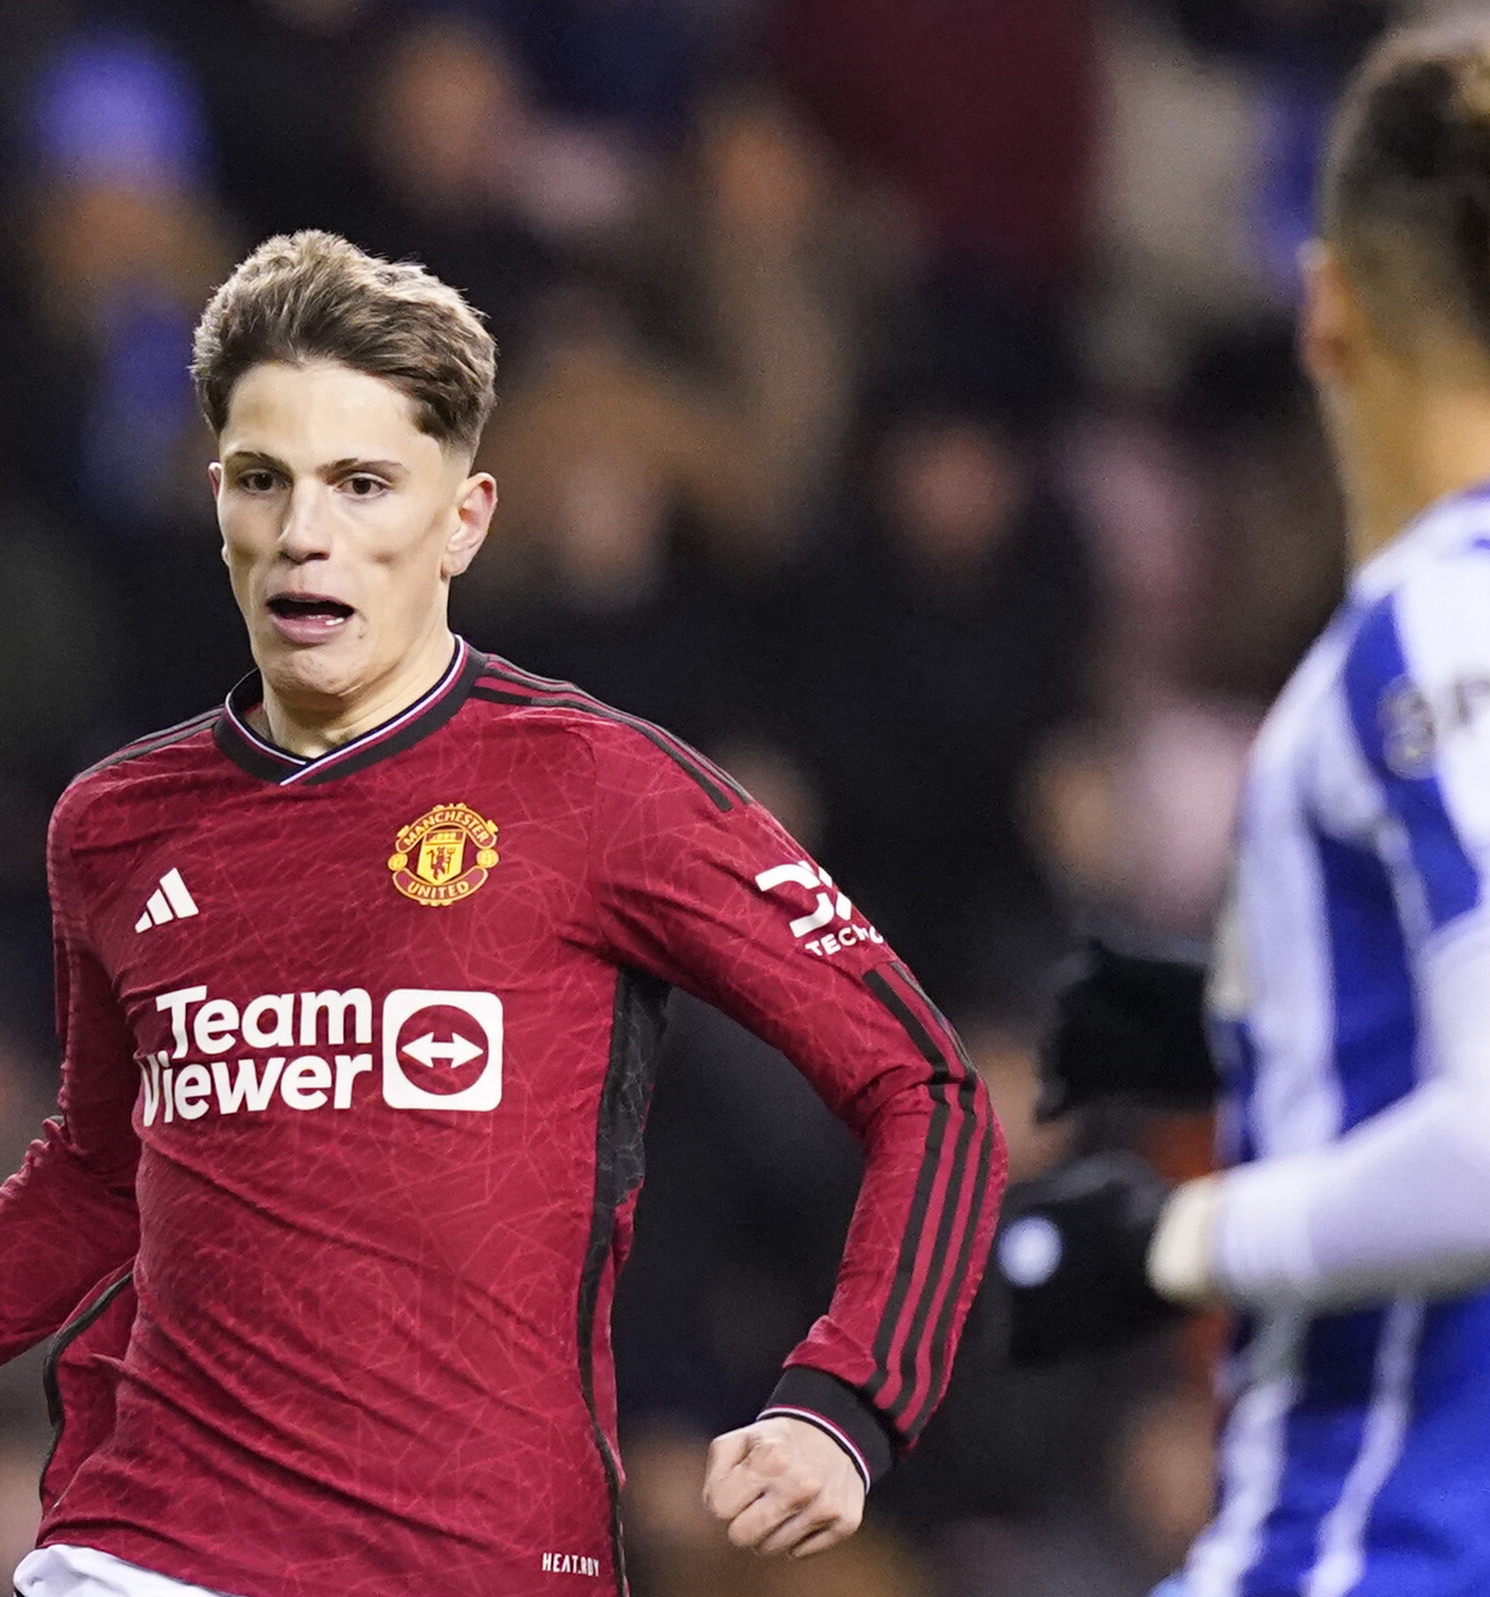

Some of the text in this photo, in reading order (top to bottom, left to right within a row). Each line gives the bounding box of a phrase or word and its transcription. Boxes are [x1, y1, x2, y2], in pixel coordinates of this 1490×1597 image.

[403, 810, 490, 847] MANCHESTER
[407, 880, 469, 900] UNITED
[156, 984, 373, 1060] Team
[139, 1050, 373, 1127] Viewer
